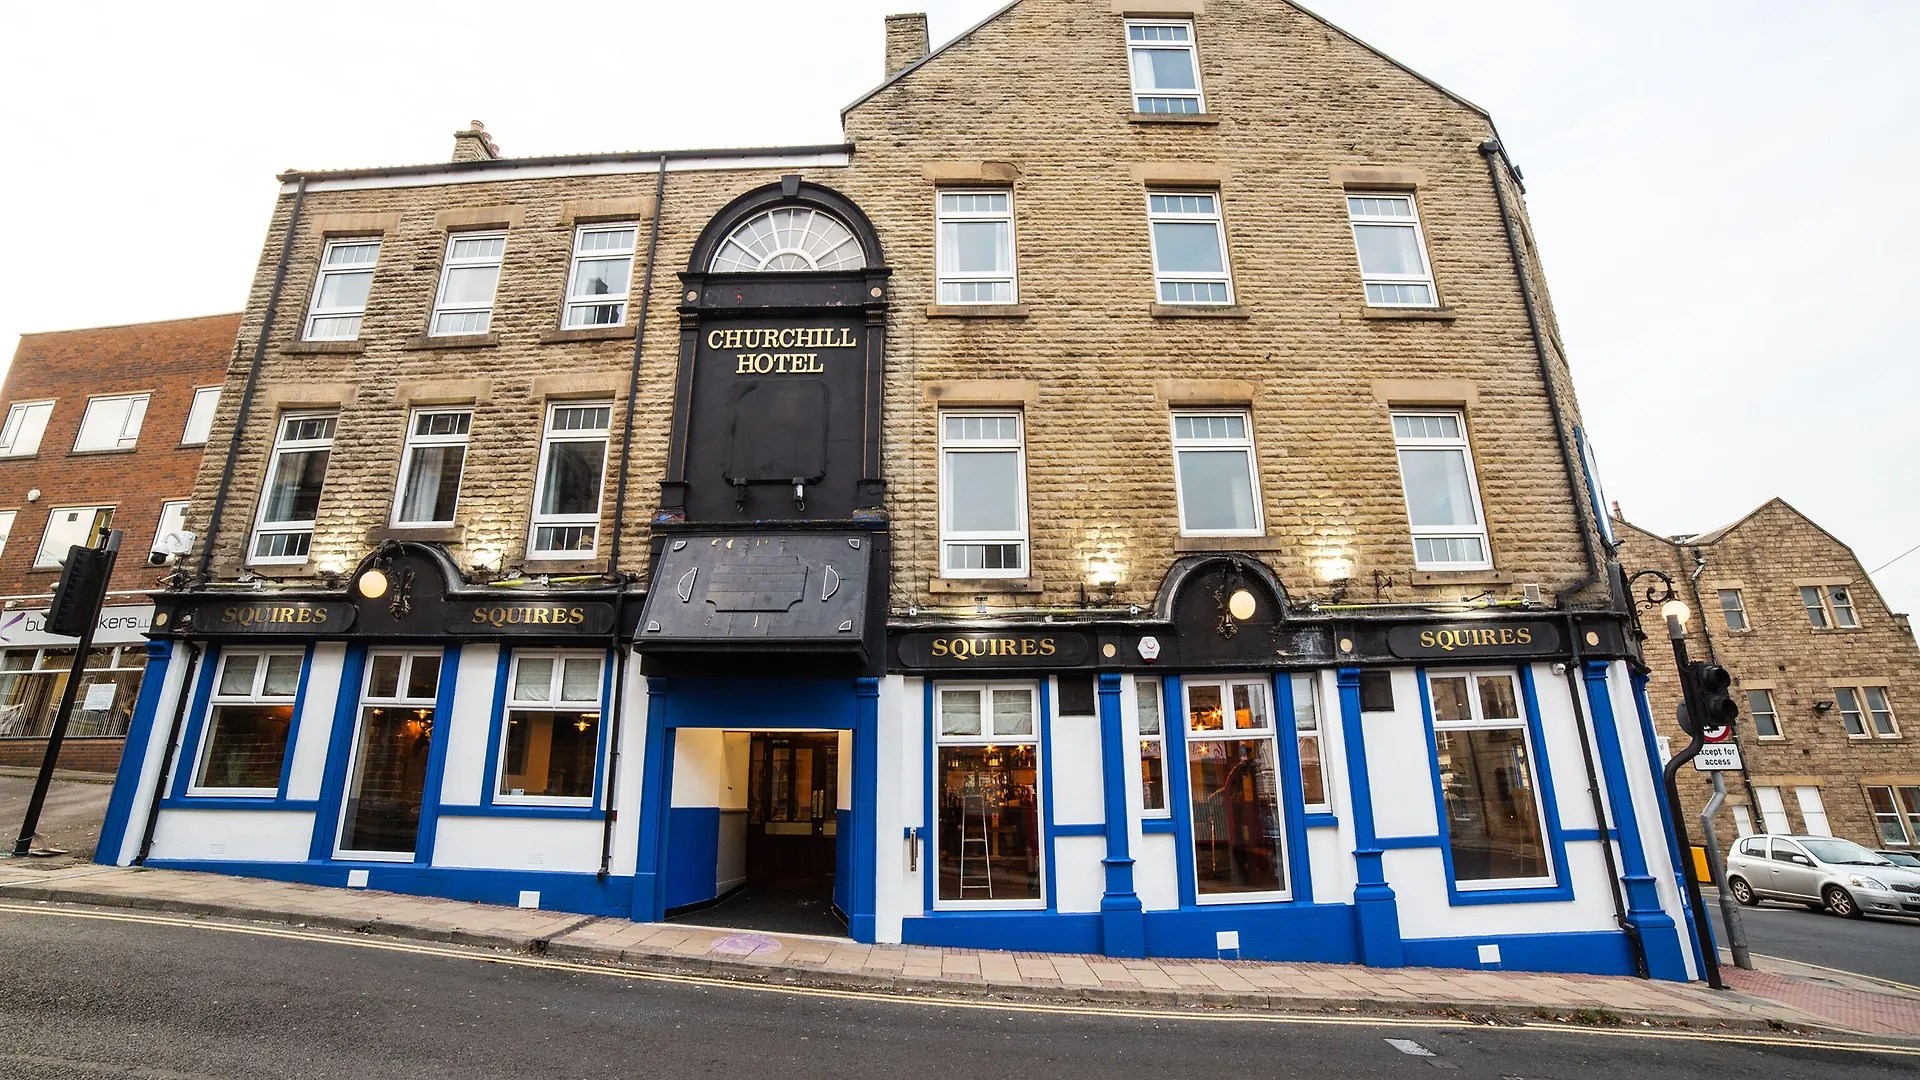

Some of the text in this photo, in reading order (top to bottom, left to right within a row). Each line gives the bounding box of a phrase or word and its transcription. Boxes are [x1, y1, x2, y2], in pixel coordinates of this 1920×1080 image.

[707, 328, 857, 349] CHURCHILL
[735, 353, 824, 374] HOTEL
[222, 607, 328, 627] SQUIRES
[471, 607, 585, 628] SQUIRES
[931, 638, 1056, 660] SQUIRES
[1419, 627, 1532, 651] SQUIRES
[1704, 758, 1731, 766] access
[1724, 747, 1735, 756] for
